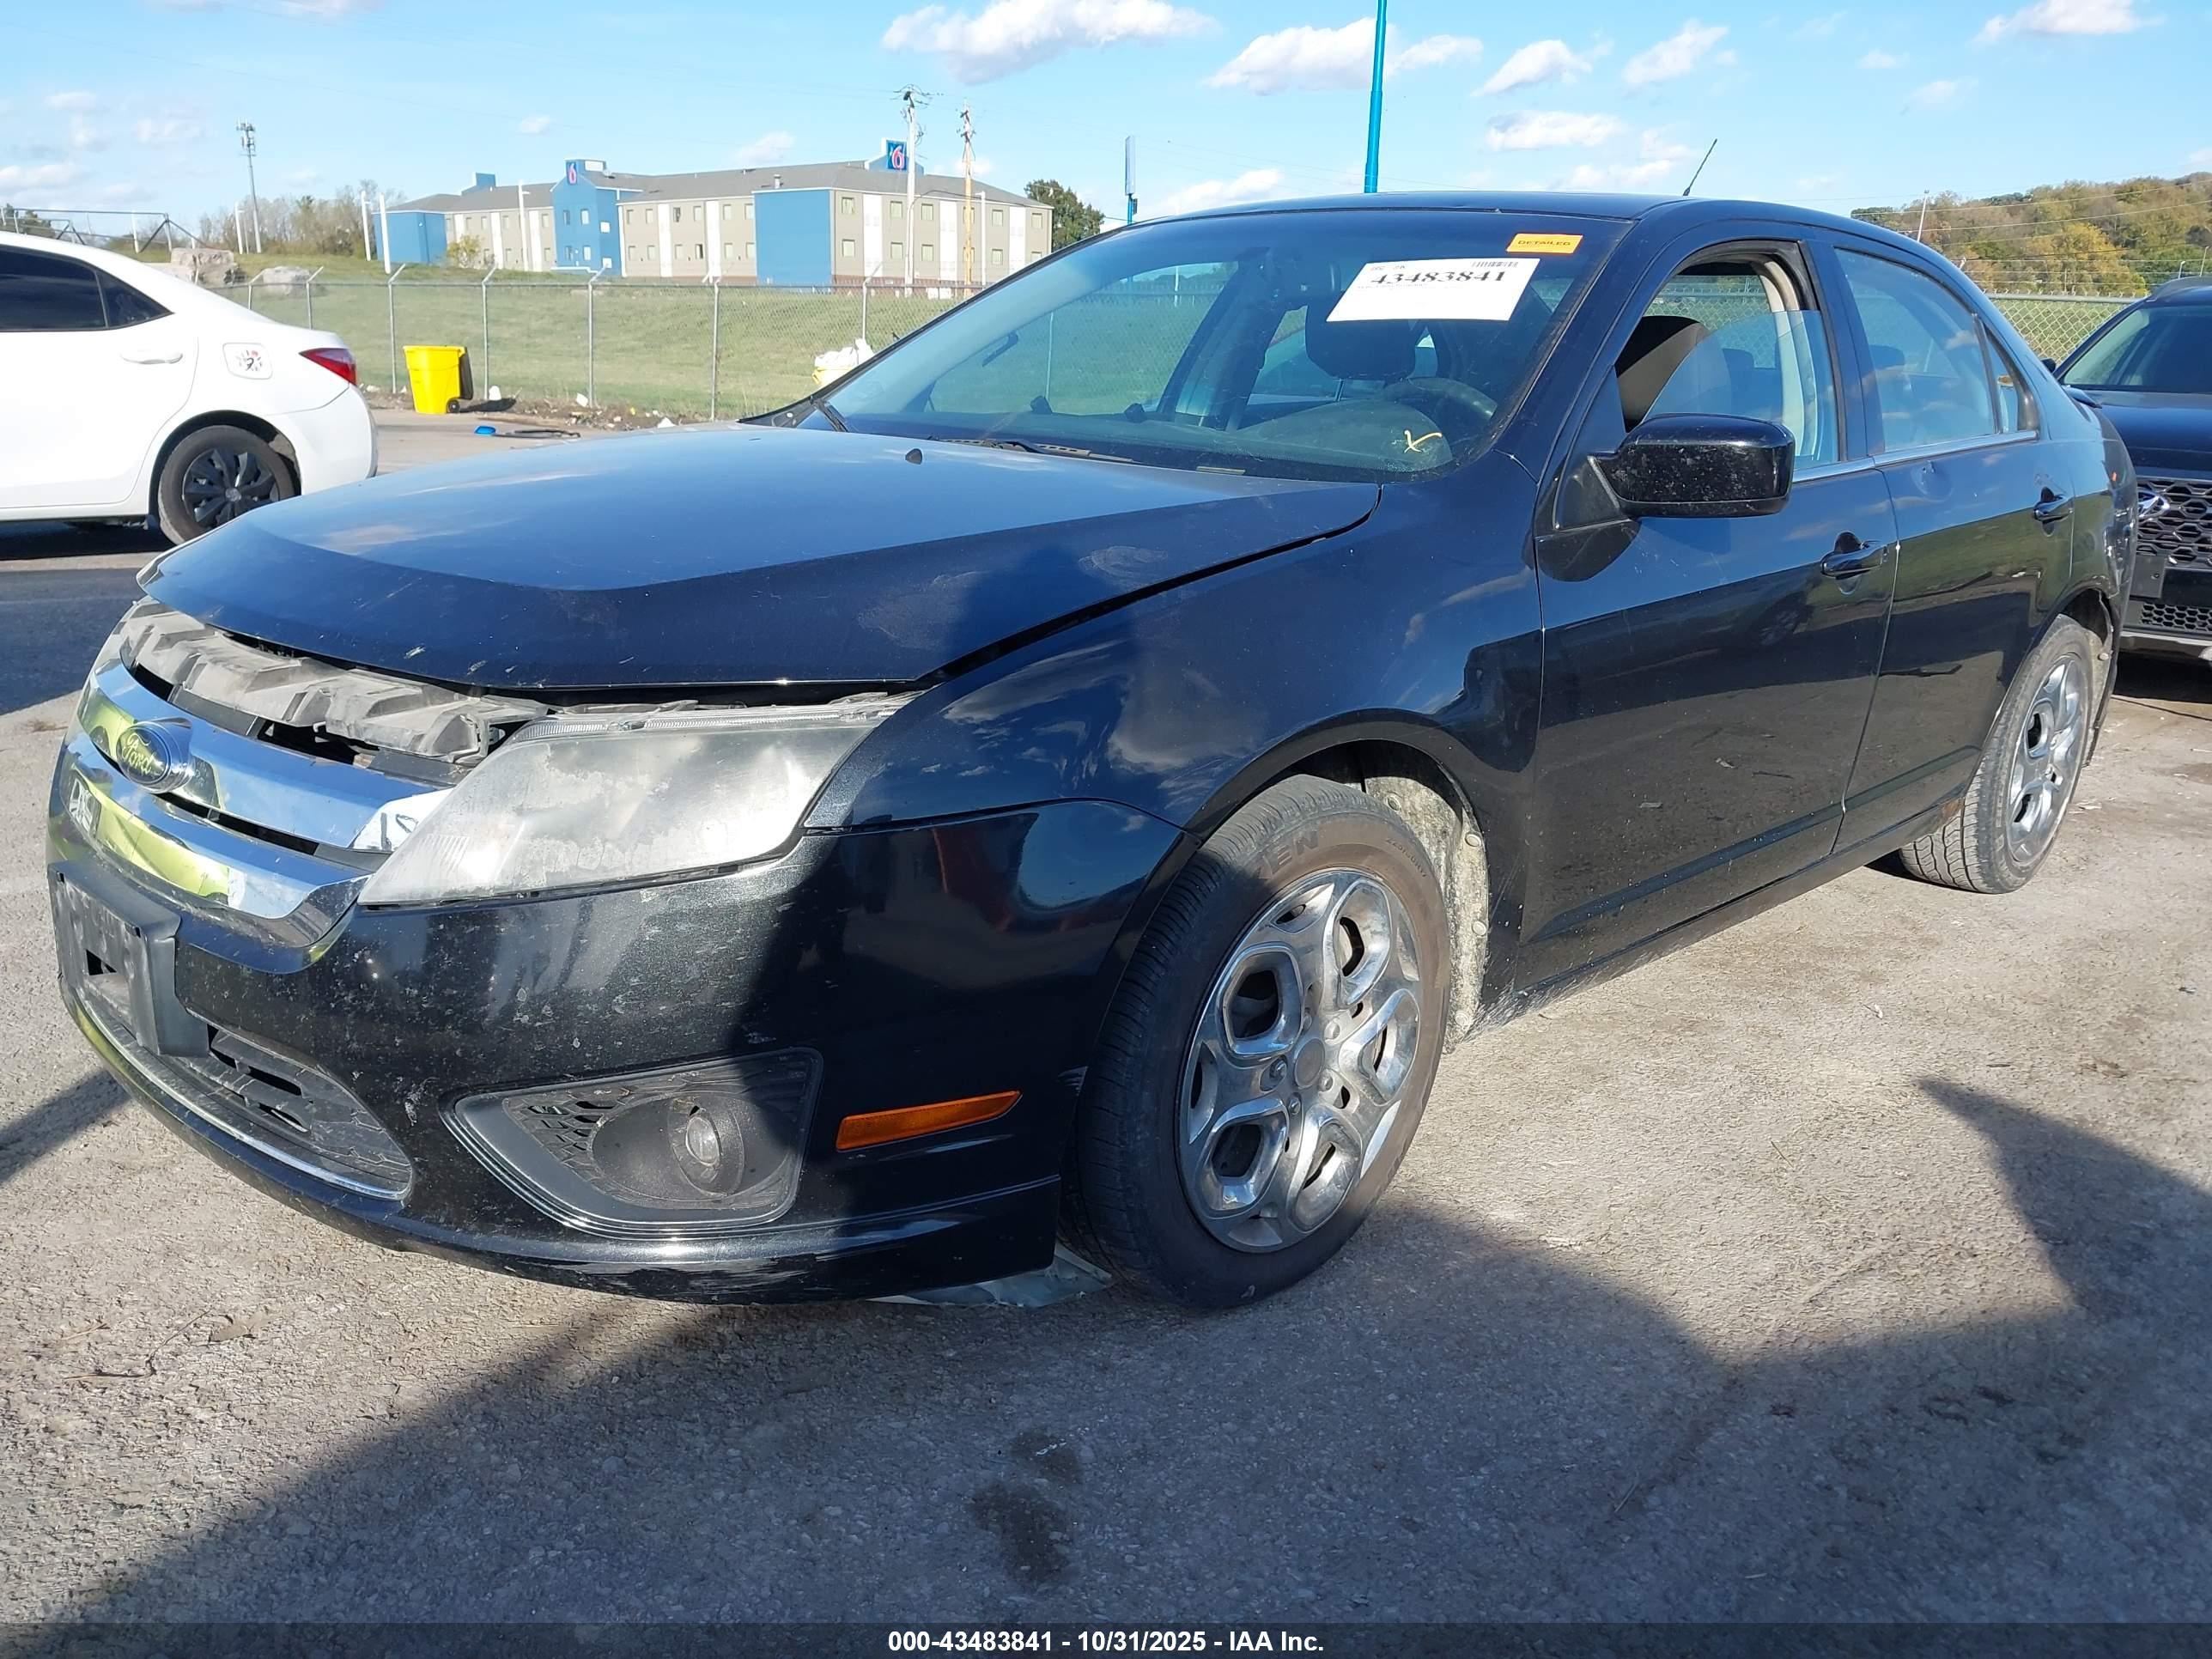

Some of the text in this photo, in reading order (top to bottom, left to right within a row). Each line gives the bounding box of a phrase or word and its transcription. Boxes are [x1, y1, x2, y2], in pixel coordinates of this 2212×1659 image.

[891, 144, 905, 170] 6
[568, 162, 577, 184] 6
[1370, 270, 1505, 284] 43483841
[122, 732, 156, 775] Ford
